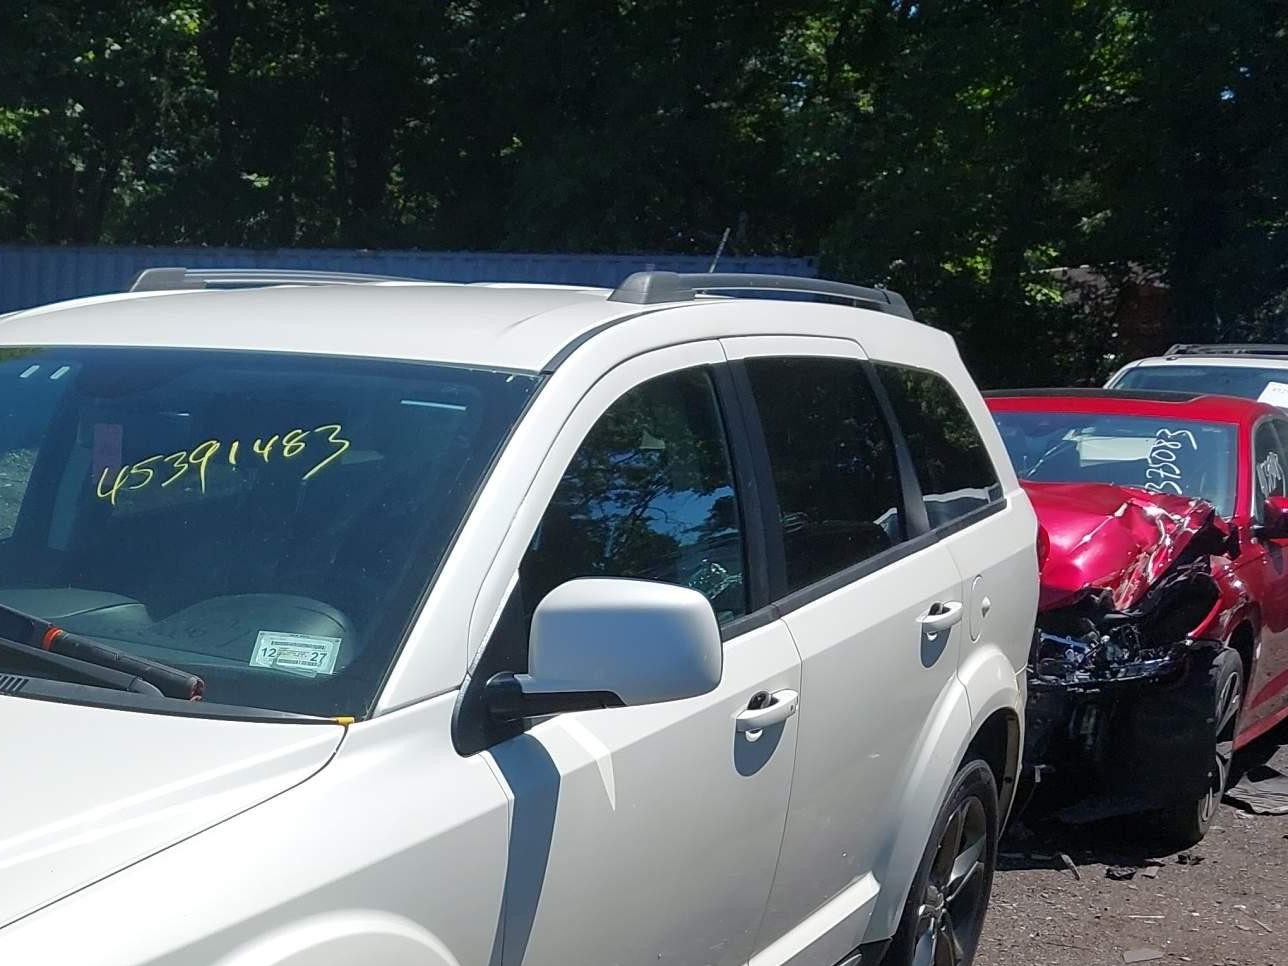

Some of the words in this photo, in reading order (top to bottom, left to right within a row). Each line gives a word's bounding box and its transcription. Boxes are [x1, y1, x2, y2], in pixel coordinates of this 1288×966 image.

[96, 424, 350, 505] 45391483
[261, 647, 277, 658] 12
[310, 652, 327, 664] 27
